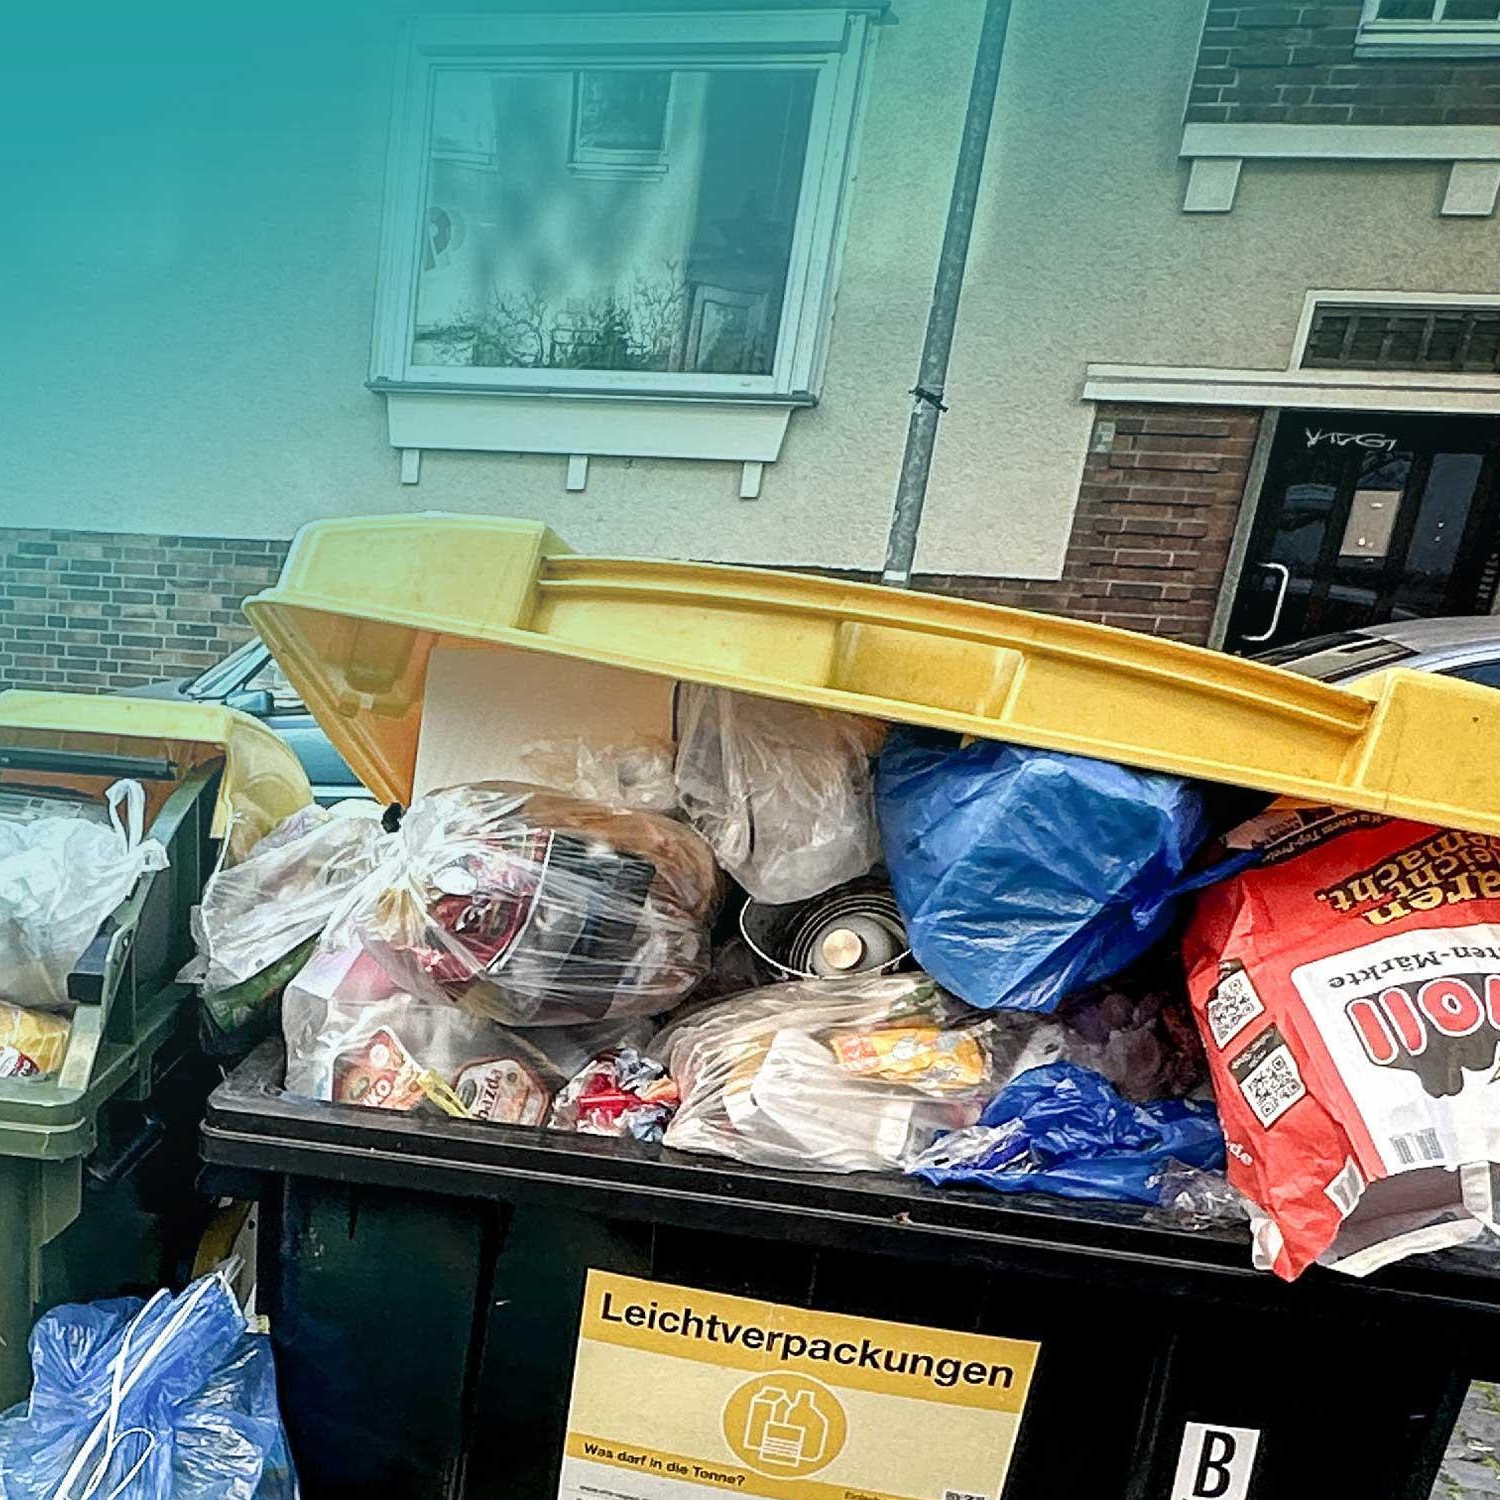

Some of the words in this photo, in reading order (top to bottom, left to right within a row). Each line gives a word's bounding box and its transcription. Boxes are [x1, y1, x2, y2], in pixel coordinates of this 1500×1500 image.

[1327, 945, 1500, 989] ten-Märkte
[601, 1292, 1014, 1389] Leichtverpackungen
[583, 1442, 614, 1460] Was
[617, 1449, 647, 1465] darf
[649, 1458, 663, 1471] in
[666, 1462, 689, 1476] die
[692, 1465, 745, 1486] Tonne?
[1192, 1430, 1237, 1499] B
